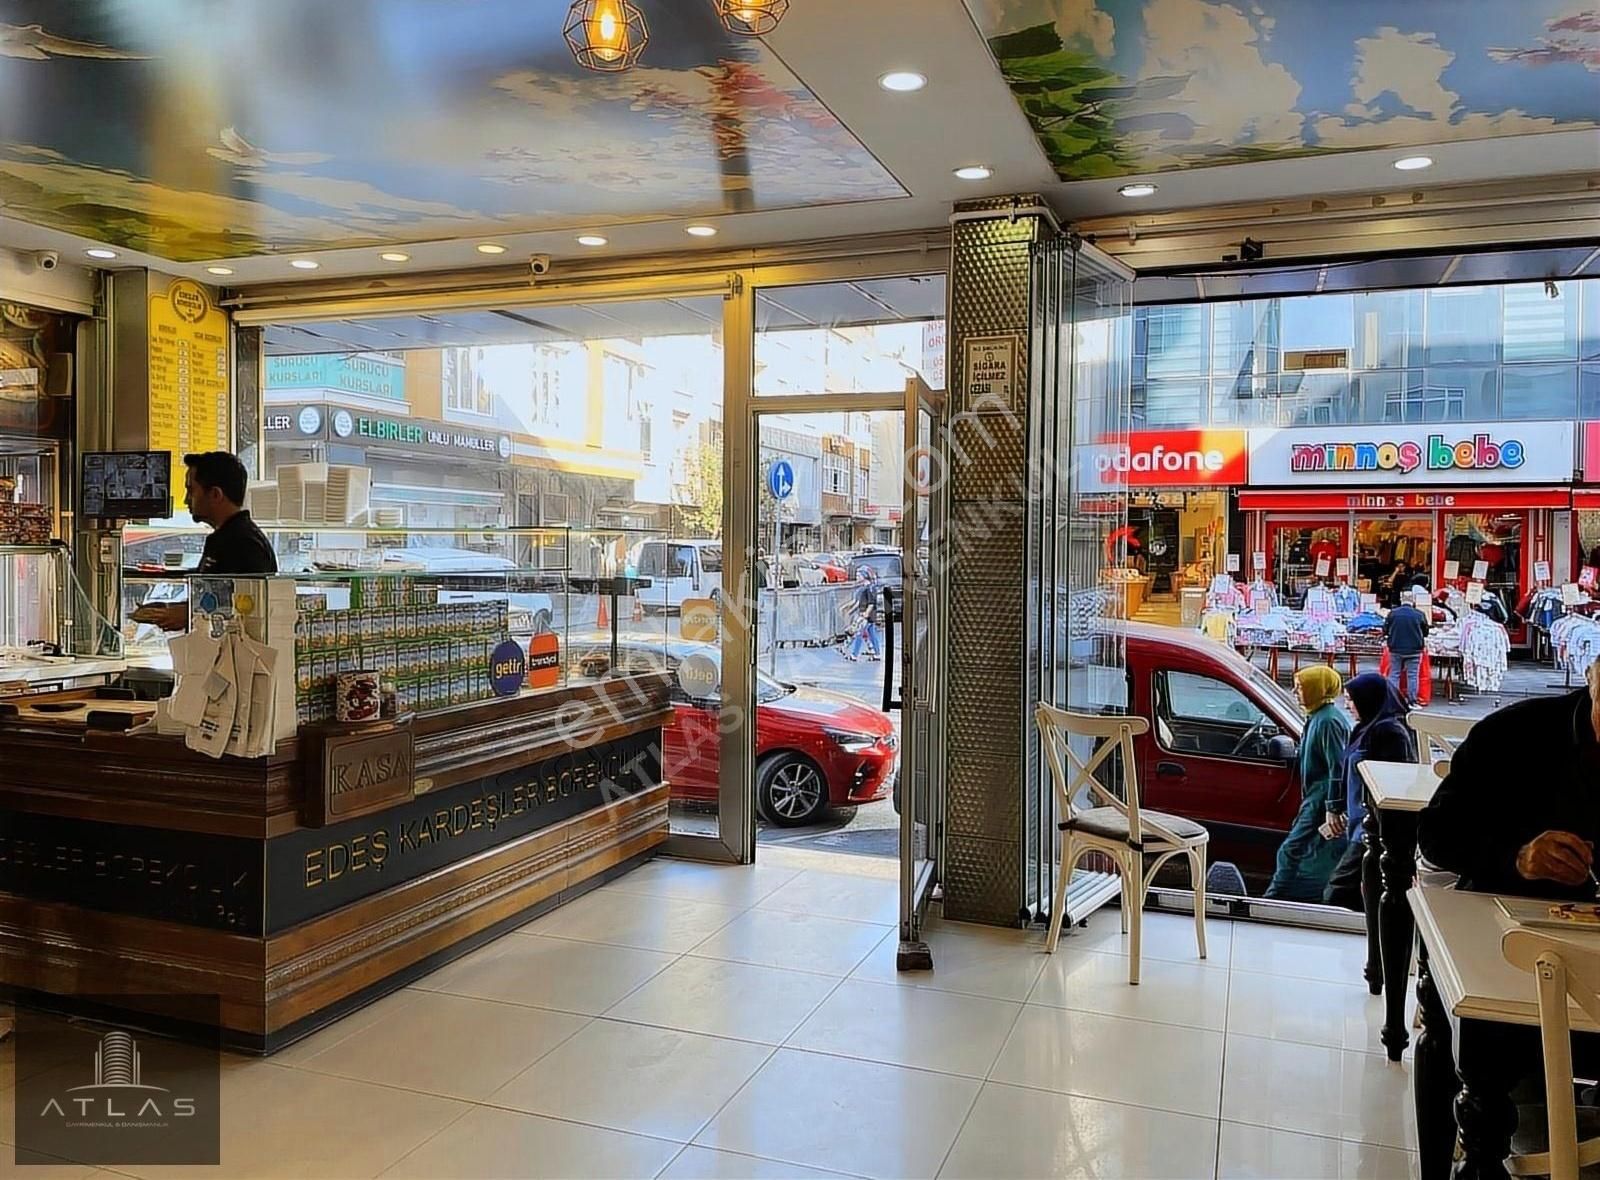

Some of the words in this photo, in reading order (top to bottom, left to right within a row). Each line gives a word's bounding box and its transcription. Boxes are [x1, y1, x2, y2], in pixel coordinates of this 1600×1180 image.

[1092, 444, 1226, 472] odafone
[1427, 433, 1526, 471] bebe
[1347, 493, 1405, 508] minns
[495, 657, 521, 680] getir
[331, 750, 410, 796] KASA
[305, 828, 391, 888] EDEŞ
[399, 780, 542, 855] KARDEŞLER
